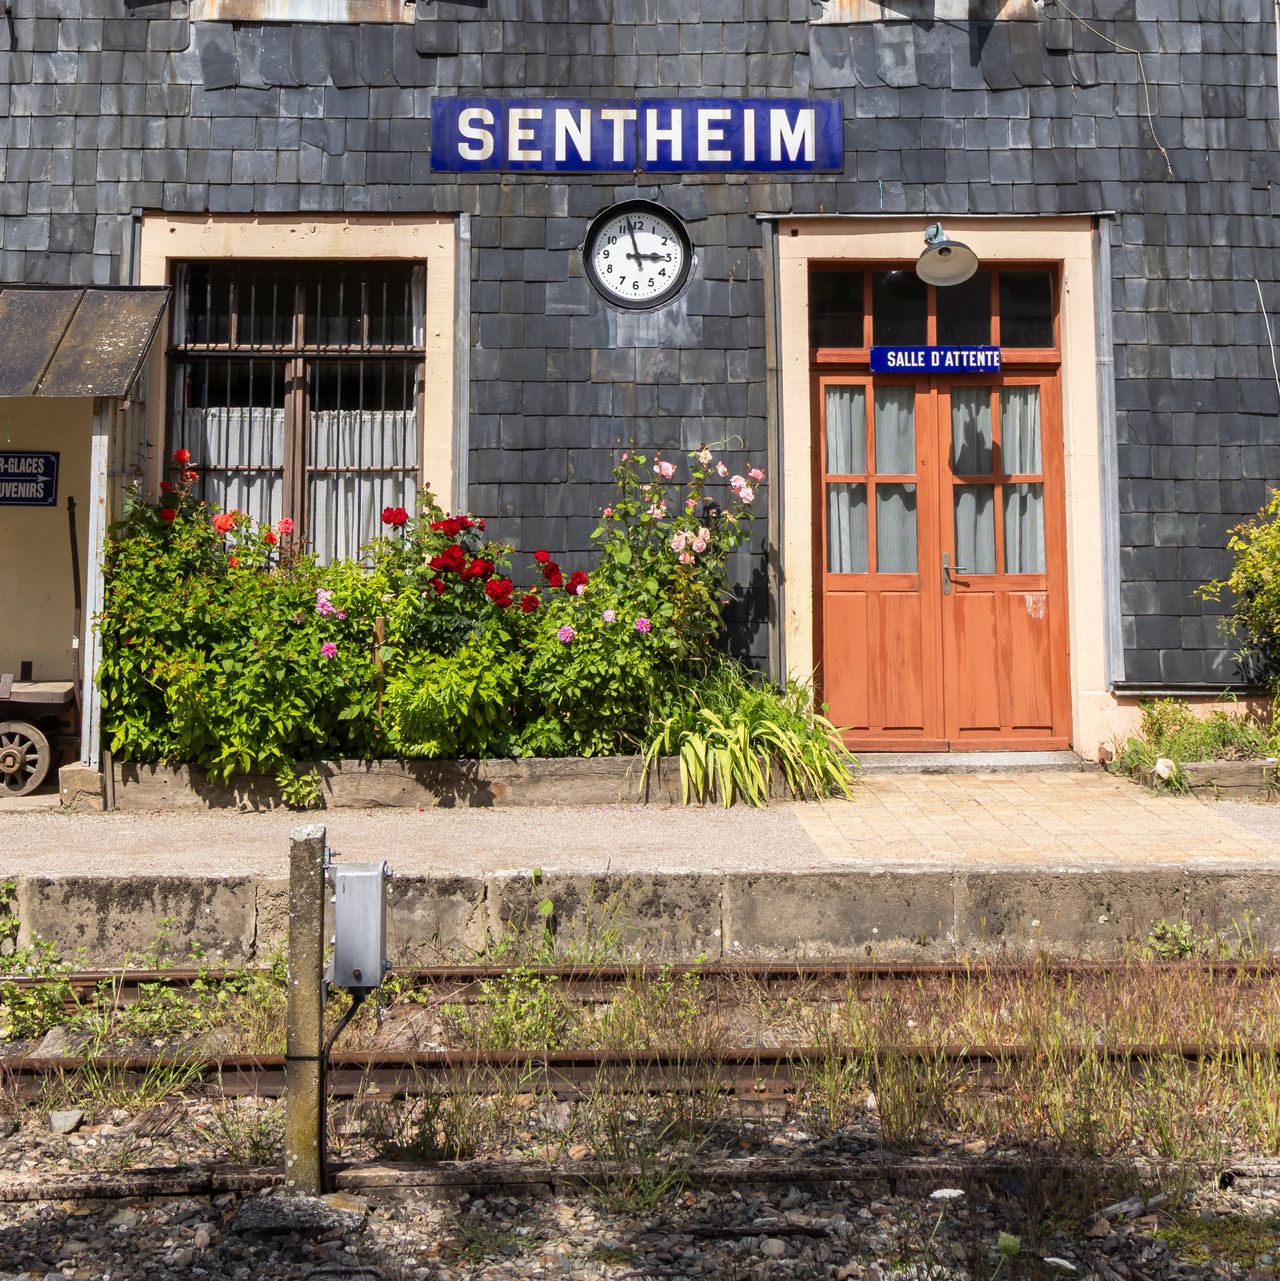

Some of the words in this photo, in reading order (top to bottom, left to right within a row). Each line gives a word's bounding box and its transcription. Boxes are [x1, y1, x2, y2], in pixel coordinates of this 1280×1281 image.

[457, 107, 815, 162] SENTHEIM
[619, 225, 626, 233] 11
[633, 221, 643, 230] 12
[607, 236, 617, 244] 10
[661, 237, 667, 245] 2
[603, 250, 609, 258] 9
[665, 253, 671, 262] 3
[607, 264, 613, 273] 8
[658, 268, 666, 276] 4
[619, 276, 626, 285] 7
[648, 278, 654, 287] 5
[632, 281, 639, 290] 6
[887, 351, 925, 366] SALLE
[931, 351, 1000, 366] D'ATTENTE
